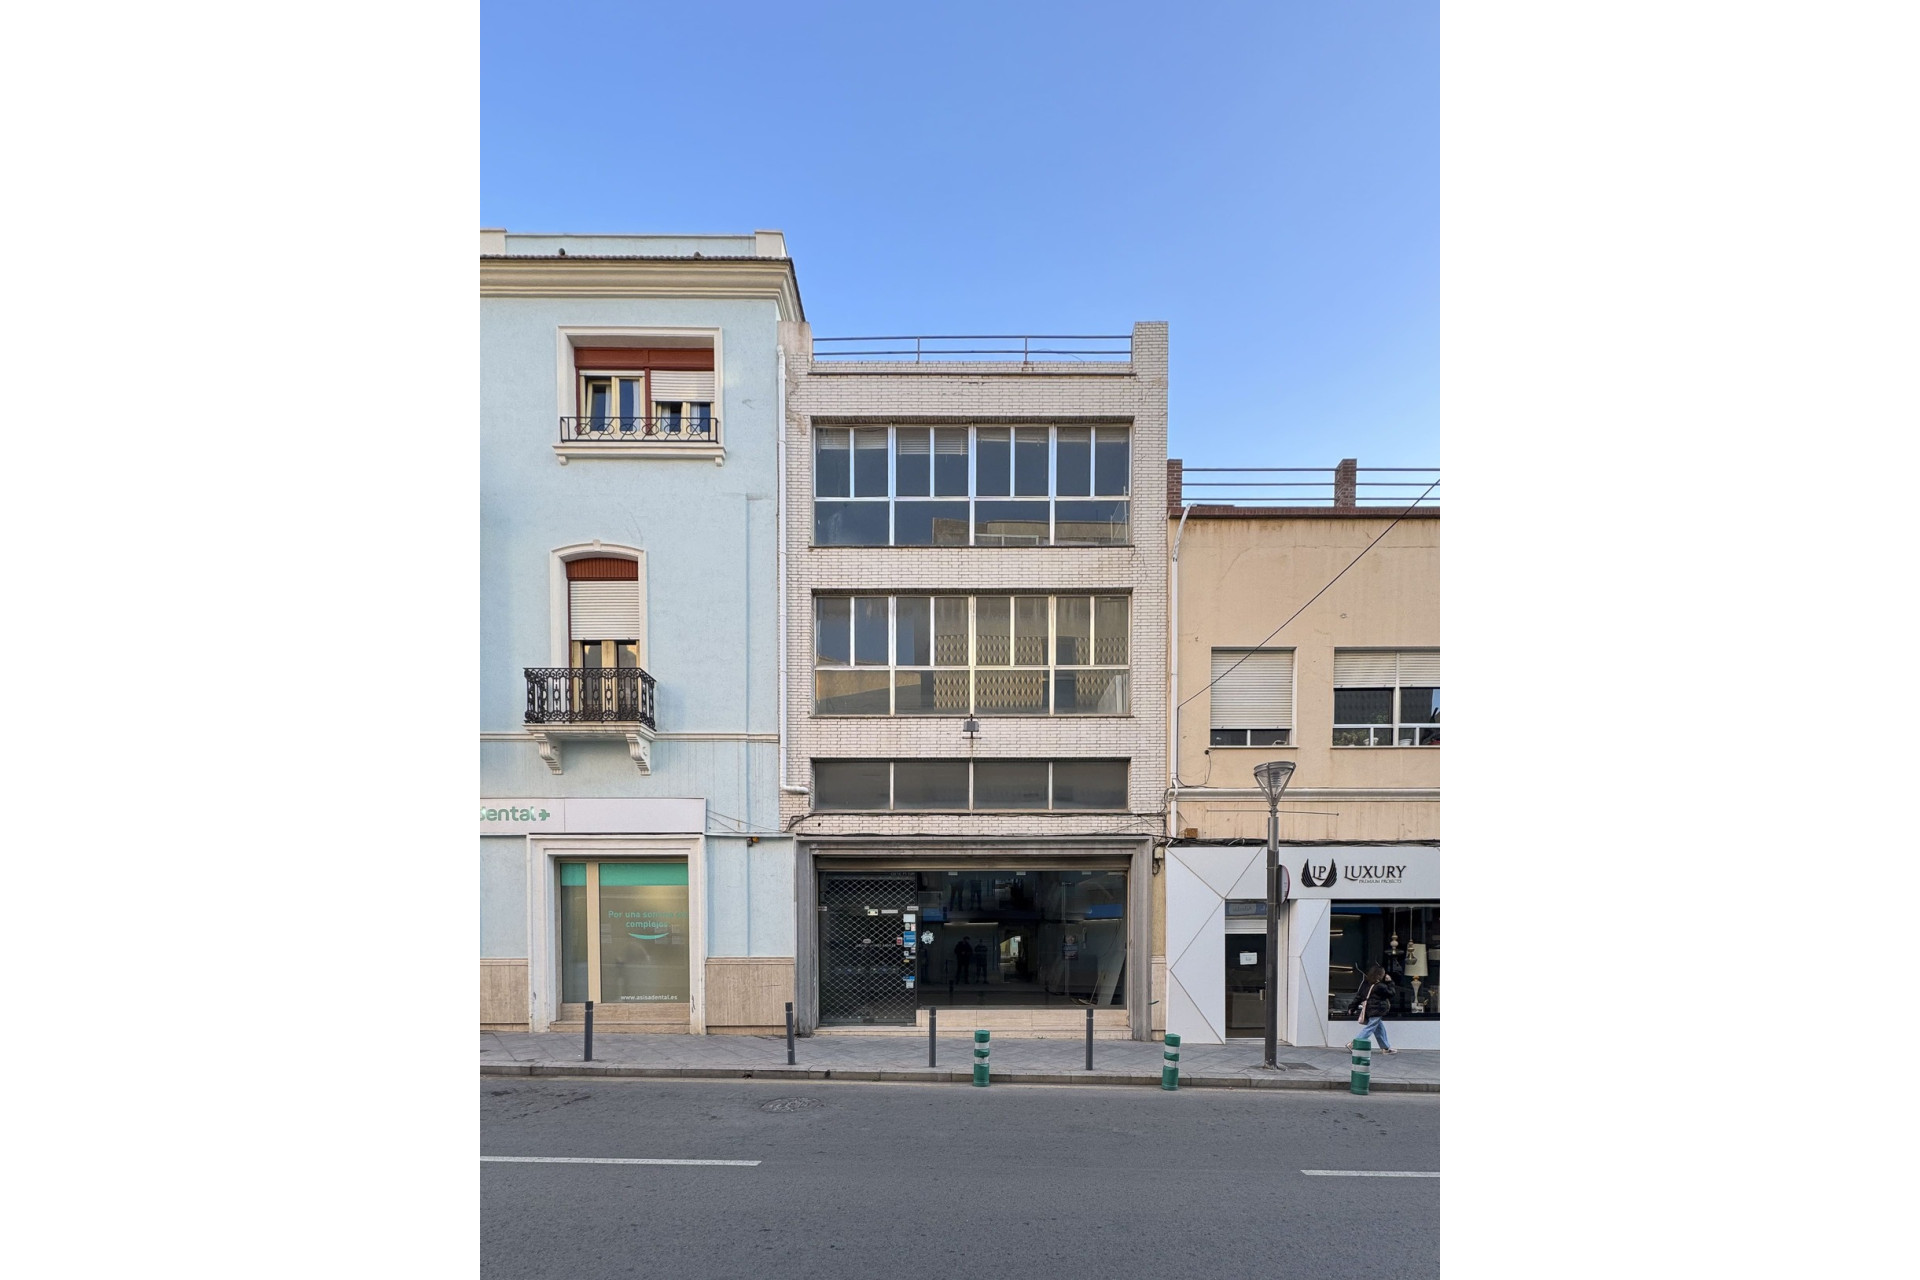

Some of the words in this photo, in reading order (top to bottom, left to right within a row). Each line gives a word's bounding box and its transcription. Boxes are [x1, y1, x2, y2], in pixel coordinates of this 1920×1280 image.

[1312, 865, 1327, 881] LP
[1344, 865, 1407, 881] LUXURY
[608, 910, 622, 918] Por
